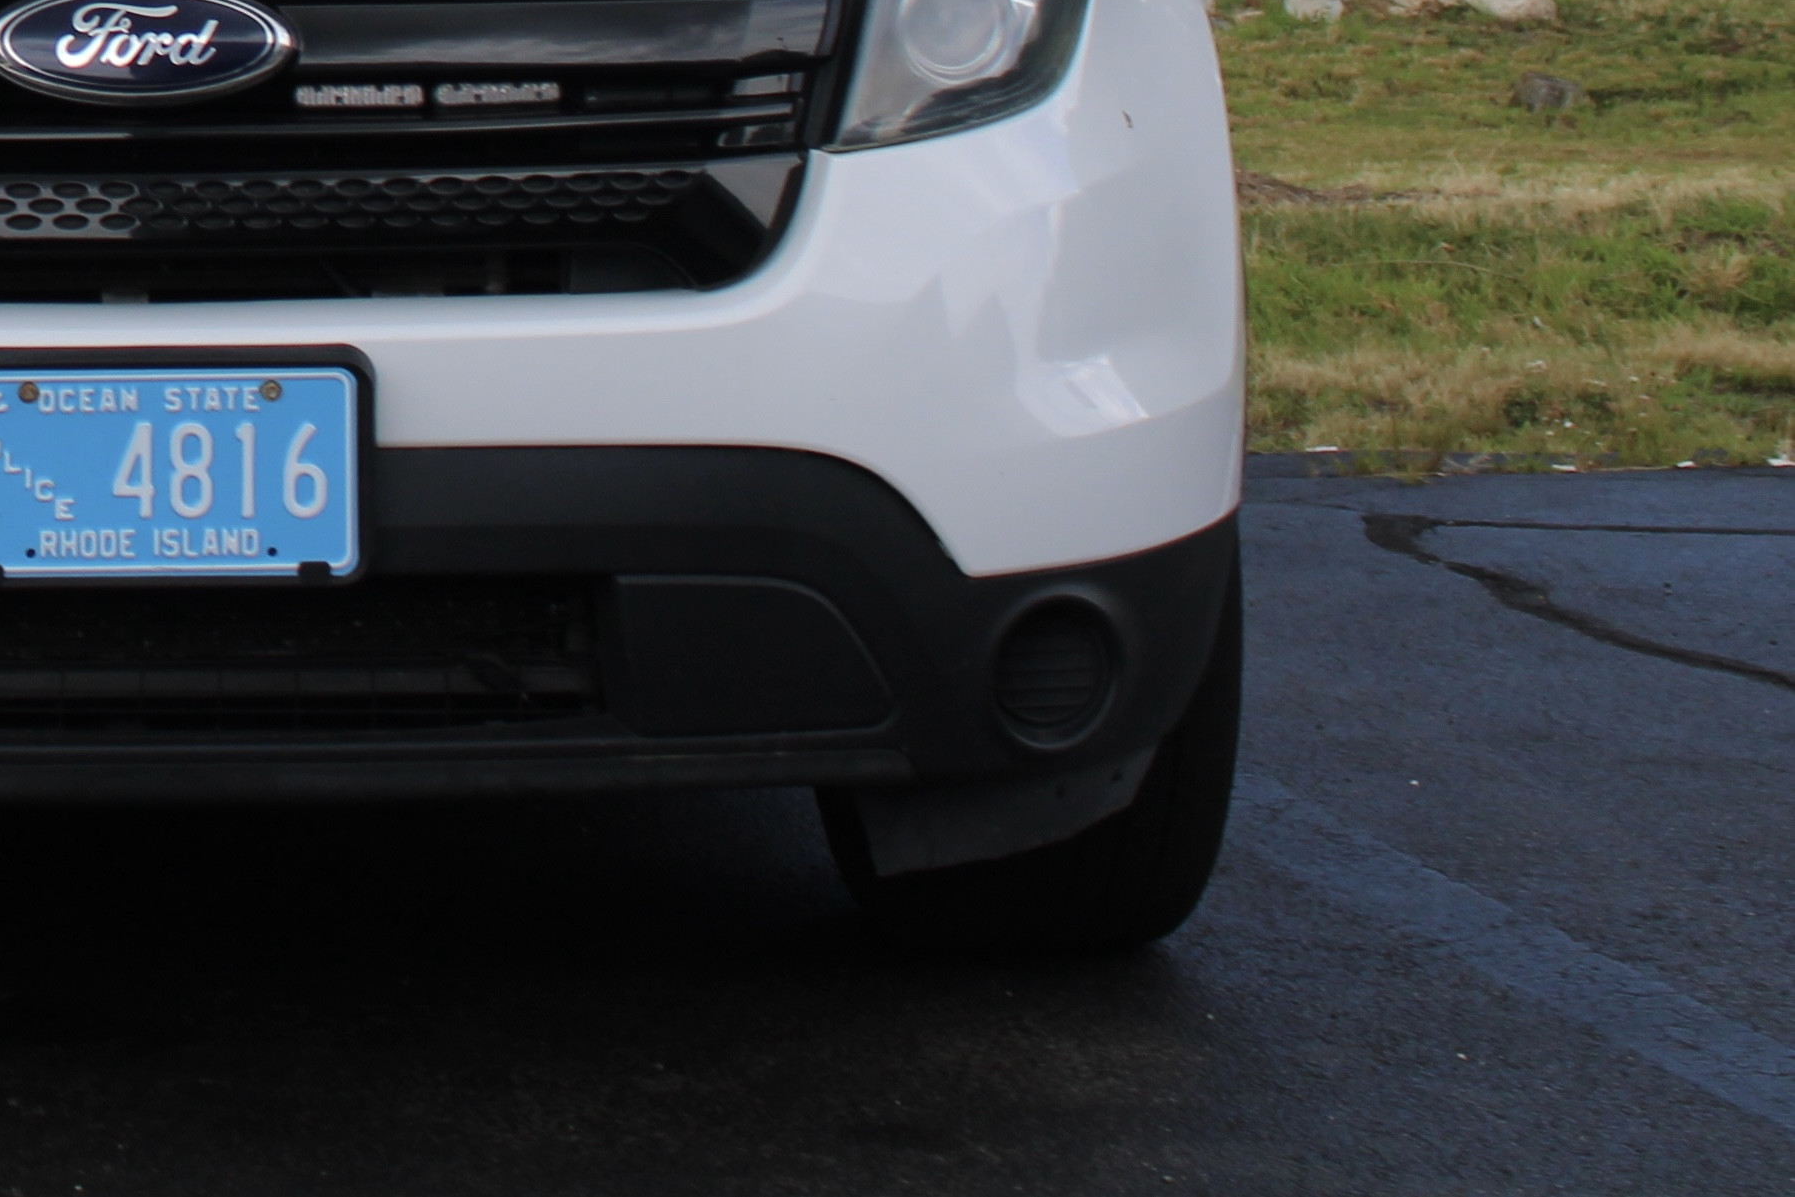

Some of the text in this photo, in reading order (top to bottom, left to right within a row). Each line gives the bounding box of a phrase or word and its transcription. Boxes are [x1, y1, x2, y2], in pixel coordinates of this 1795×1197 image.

[55, 2, 219, 69] Ford
[38, 386, 261, 413] OCEAN STATE
[112, 421, 329, 520] 4816
[39, 527, 261, 559] RHODE ISLAND
